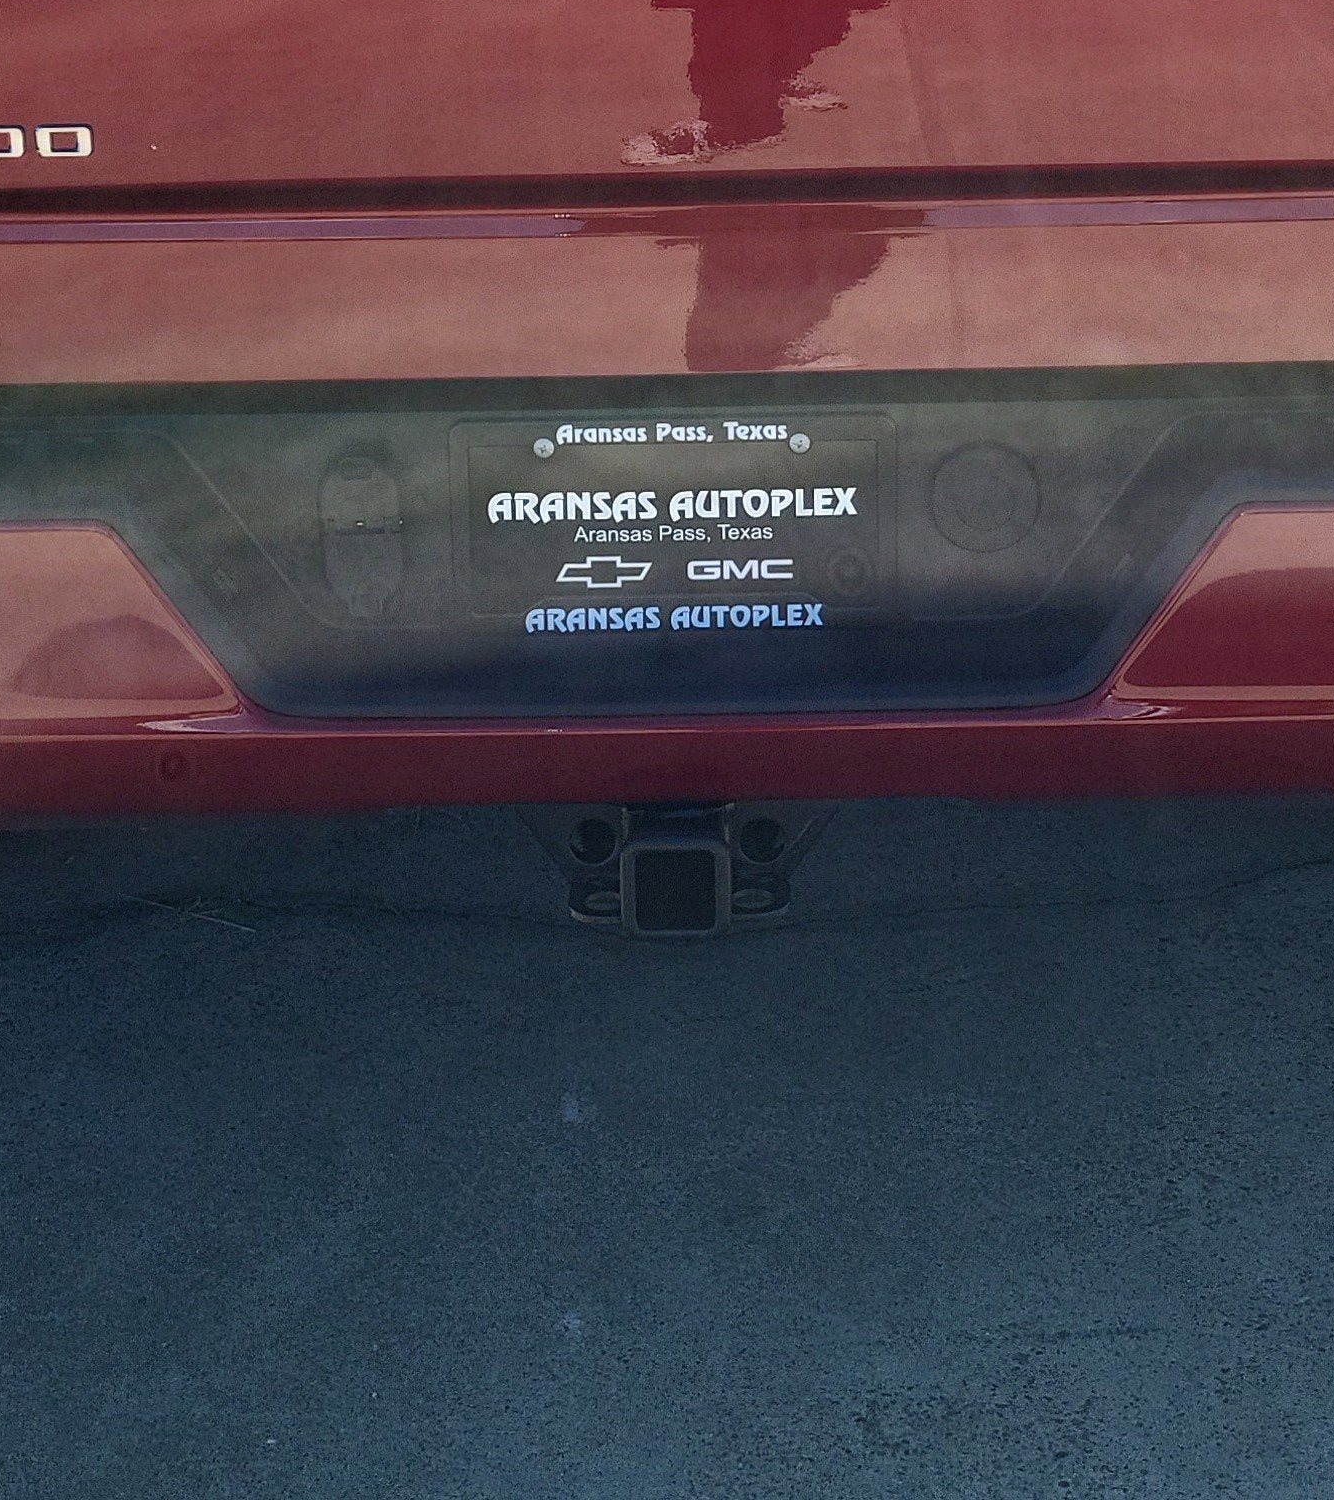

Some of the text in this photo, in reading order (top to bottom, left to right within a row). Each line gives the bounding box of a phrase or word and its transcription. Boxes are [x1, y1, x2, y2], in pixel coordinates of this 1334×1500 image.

[555, 421, 788, 445] Aransas Pass, Texas
[487, 487, 859, 524] ARANSAS AUTOPLEX
[574, 524, 774, 543] Aransas Pass, Texas
[687, 558, 794, 580] GMC
[525, 603, 824, 633] ARANSAS AUTOPLEX
